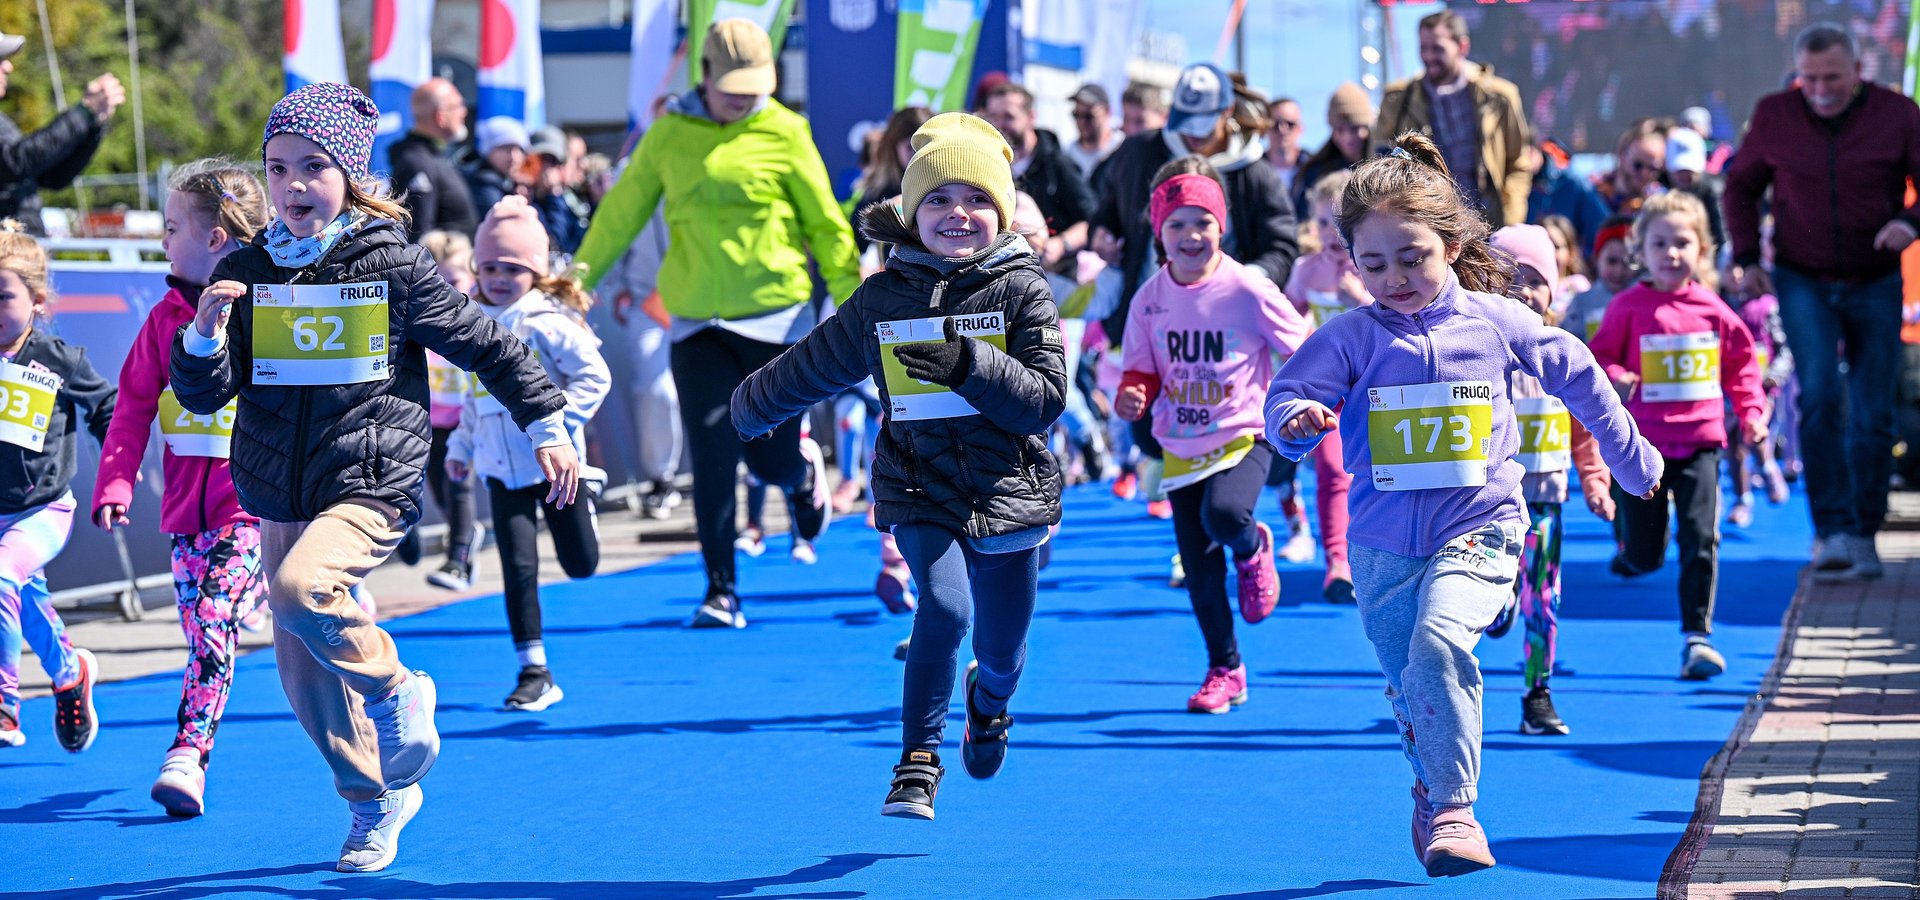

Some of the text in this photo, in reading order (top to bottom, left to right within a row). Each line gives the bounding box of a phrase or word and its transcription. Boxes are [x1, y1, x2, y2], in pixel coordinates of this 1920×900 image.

[293, 315, 346, 351] 62
[1167, 330, 1223, 364] RUN
[1662, 353, 1708, 379] 192
[1168, 380, 1222, 406] WILD
[1393, 415, 1473, 454] 173
